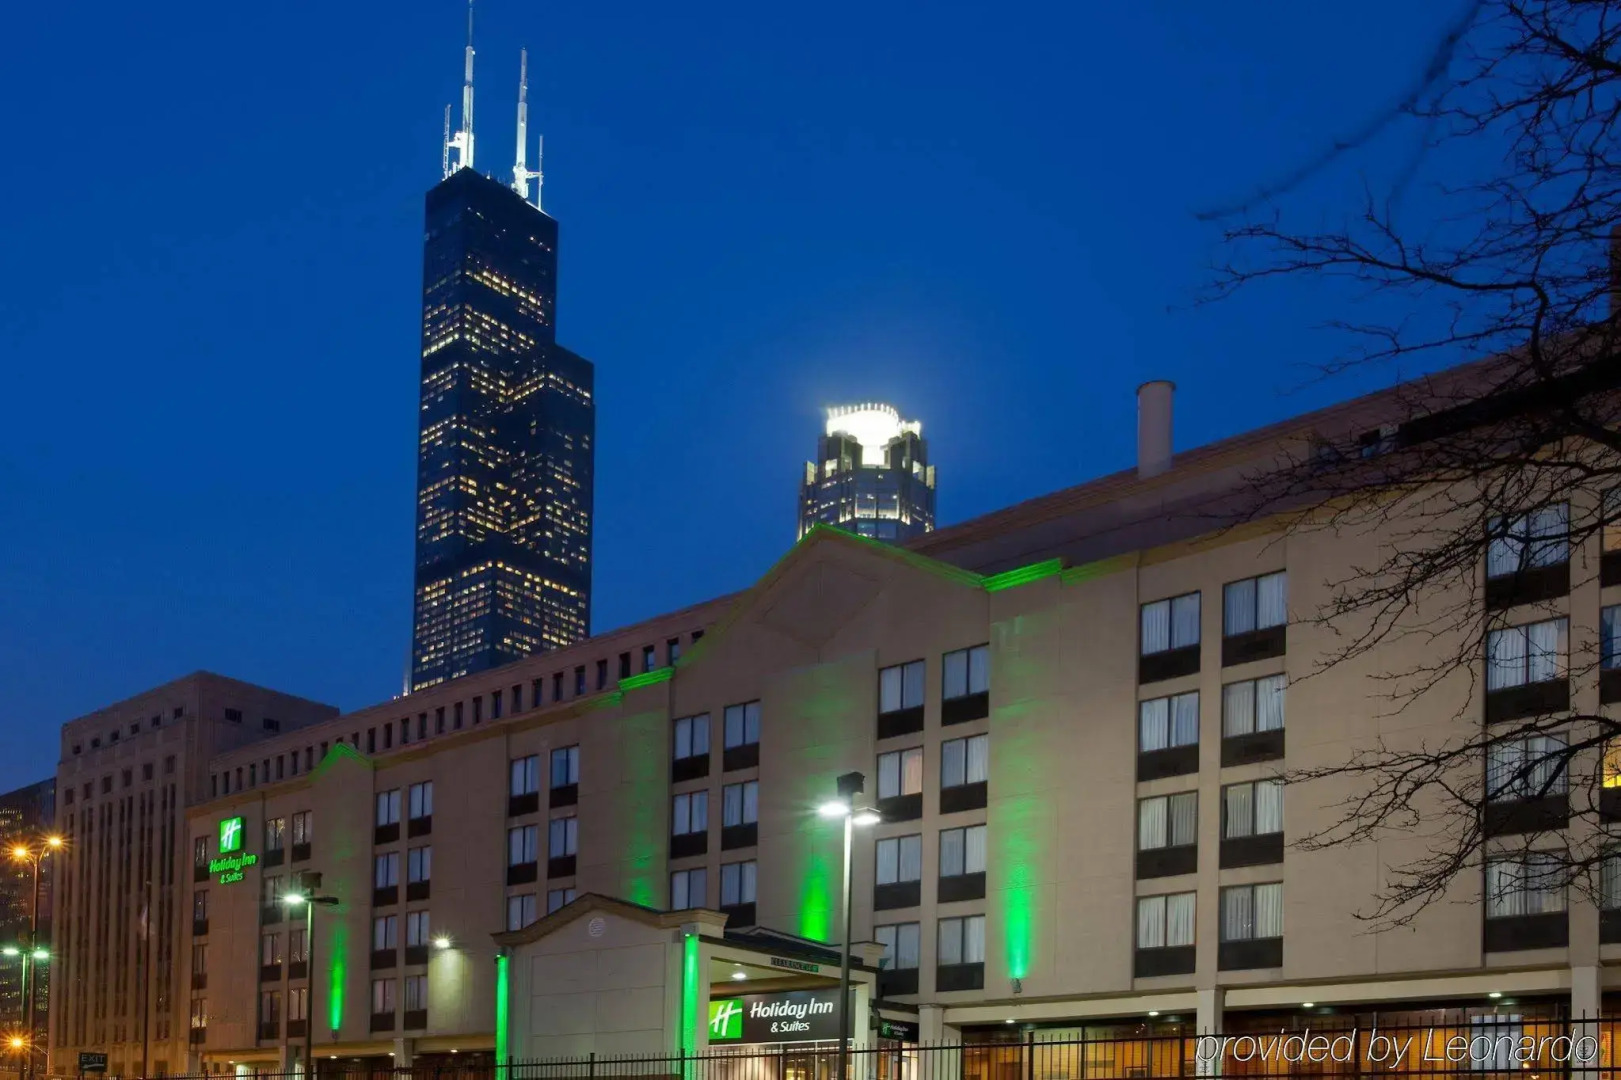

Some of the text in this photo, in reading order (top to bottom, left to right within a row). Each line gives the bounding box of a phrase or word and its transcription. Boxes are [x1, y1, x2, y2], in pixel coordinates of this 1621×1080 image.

[209, 852, 256, 872] Holiday Inn
[750, 998, 834, 1019] Holiday Inn
[770, 1020, 810, 1033] & Suites
[81, 1054, 106, 1062] EXIT
